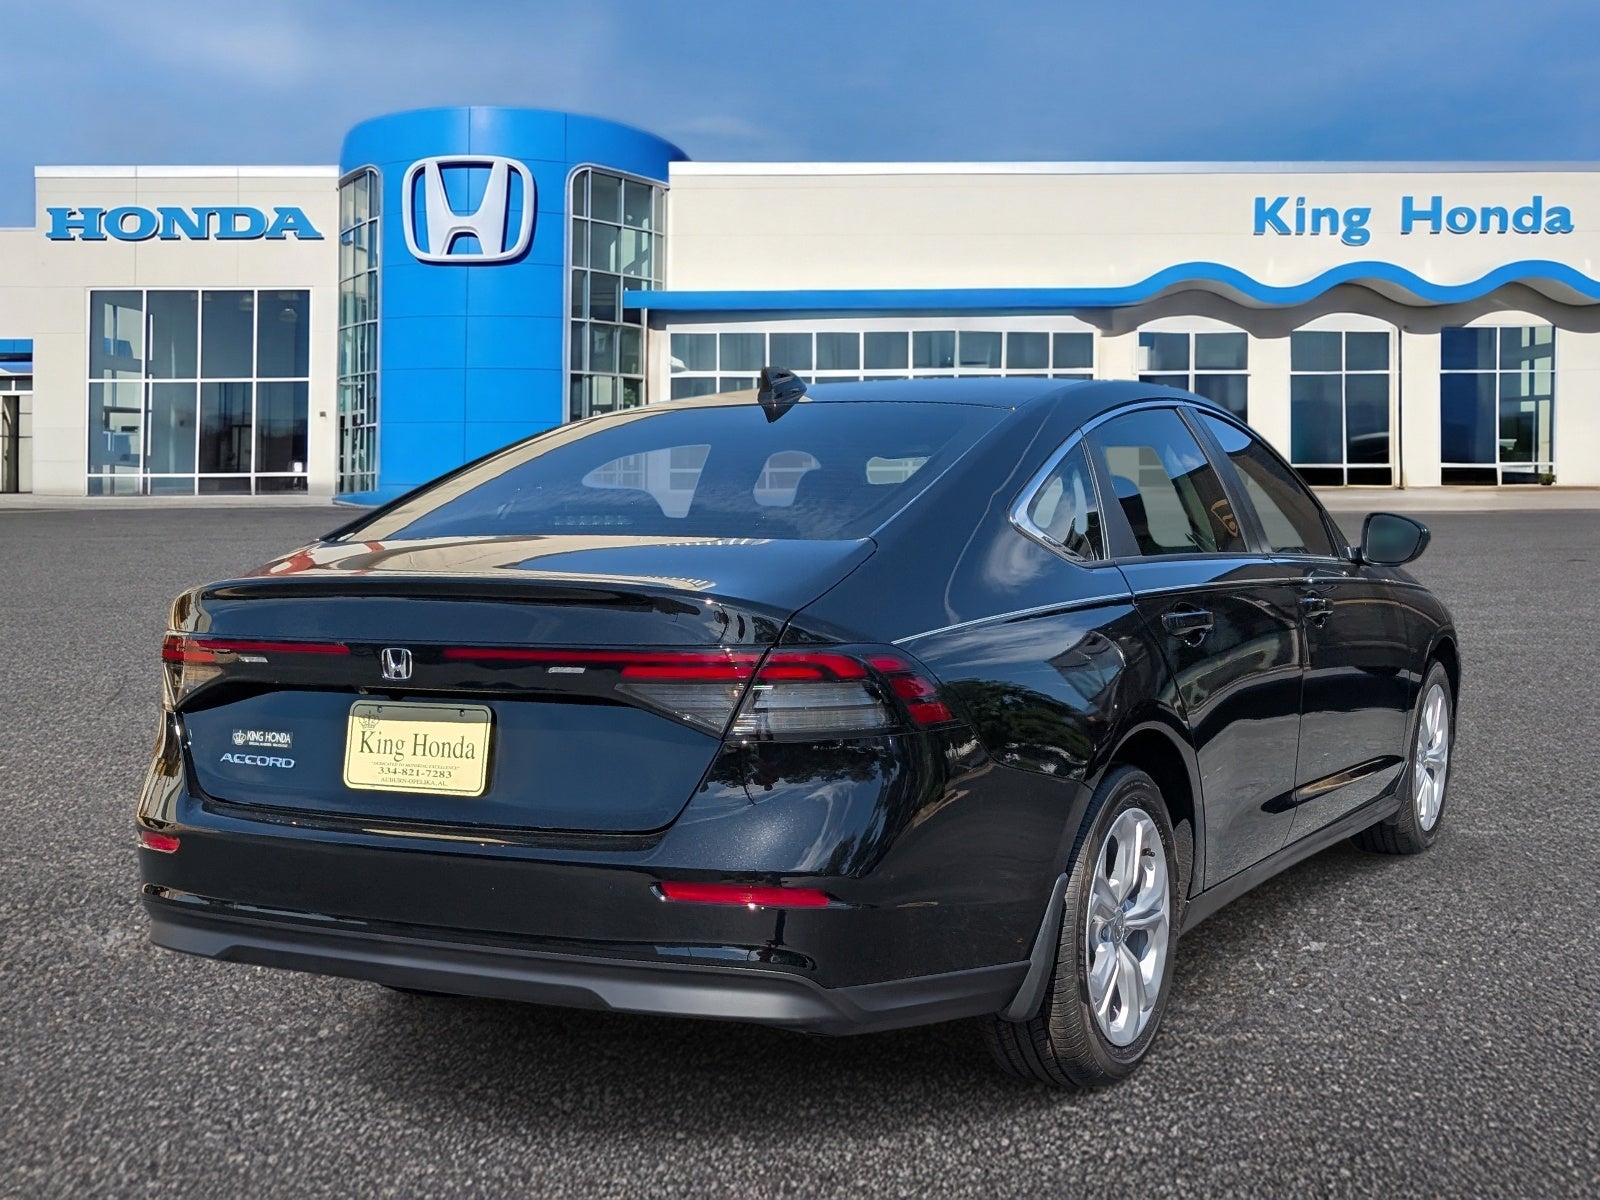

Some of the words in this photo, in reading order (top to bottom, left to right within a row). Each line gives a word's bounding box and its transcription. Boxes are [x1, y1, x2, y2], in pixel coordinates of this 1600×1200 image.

[45, 206, 325, 241] HONDA
[1253, 196, 1372, 247] King
[1400, 195, 1575, 235] Honda
[246, 730, 264, 742] KING
[265, 732, 291, 743] HONDA
[359, 730, 406, 762] King
[411, 733, 475, 760] Honda
[219, 753, 295, 768] ACCORD
[377, 766, 452, 779] 334-821-7283
